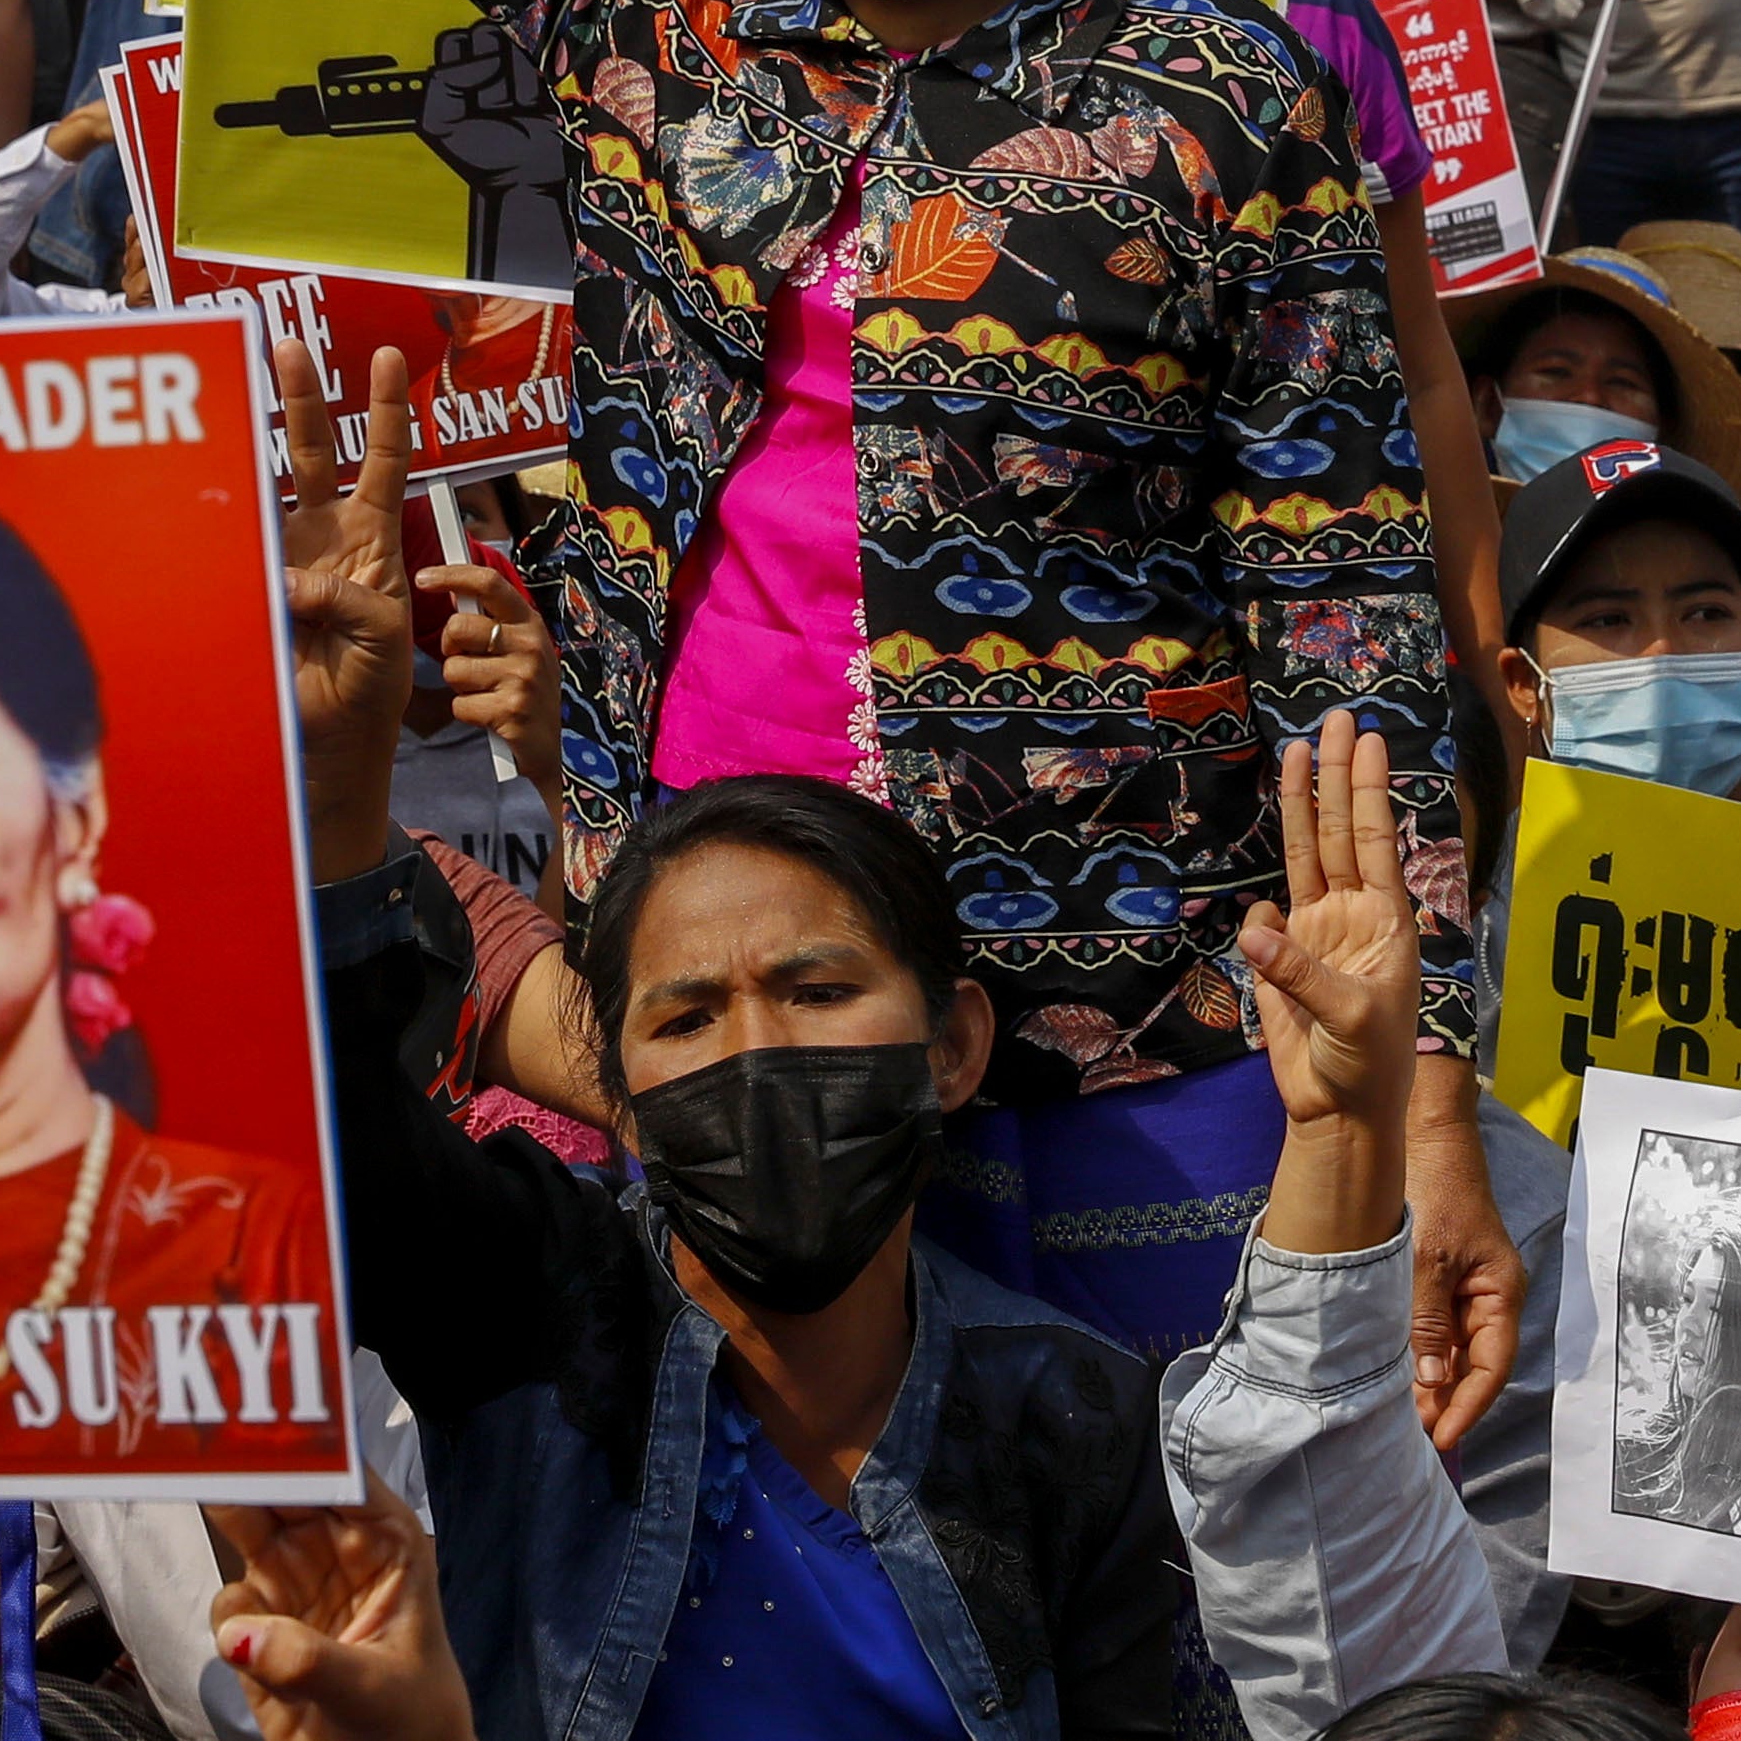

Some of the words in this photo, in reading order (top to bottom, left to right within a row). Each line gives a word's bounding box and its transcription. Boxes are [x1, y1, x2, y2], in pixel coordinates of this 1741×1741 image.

[1450, 88, 1492, 119] THE
[431, 387, 509, 446] SAN
[2, 1306, 120, 1428] SU
[145, 1301, 333, 1426] KYI
